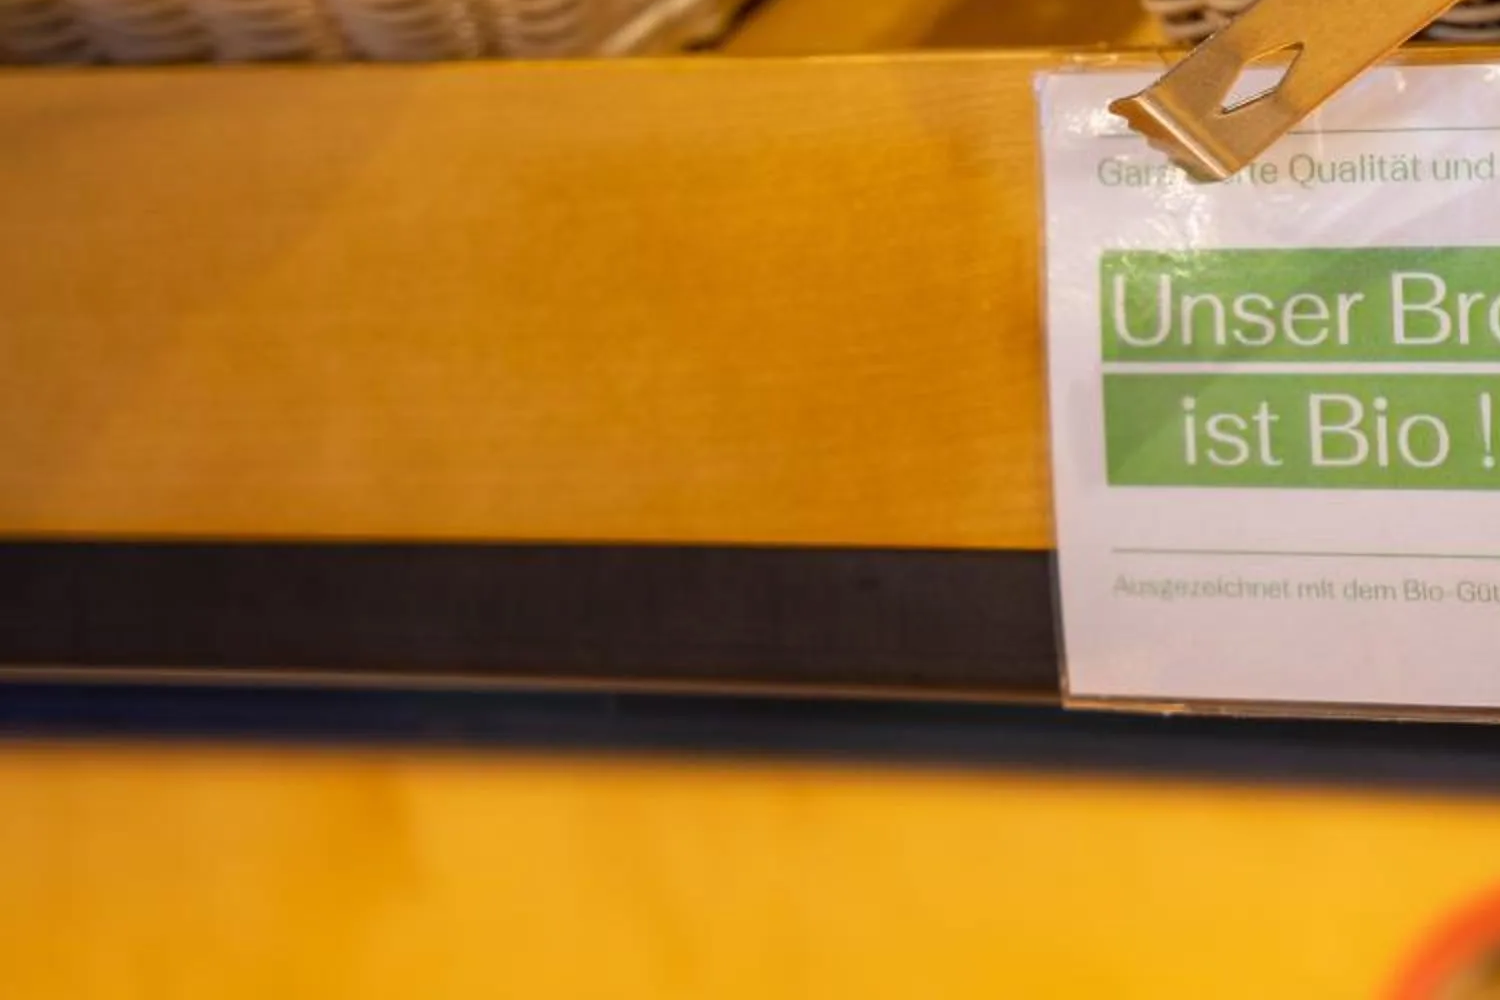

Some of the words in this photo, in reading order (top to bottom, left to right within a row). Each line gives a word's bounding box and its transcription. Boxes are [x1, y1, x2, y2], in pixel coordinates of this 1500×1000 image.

[1097, 156, 1277, 187] Garate
[1289, 153, 1421, 187] Qualität
[1432, 152, 1496, 181] und
[1113, 273, 1364, 346] Unser
[1182, 395, 1283, 467] ist
[1308, 392, 1450, 467] Bio
[1113, 574, 1289, 602] Ausgezeichnet
[1297, 576, 1335, 600] mit
[1343, 578, 1398, 602] dem
